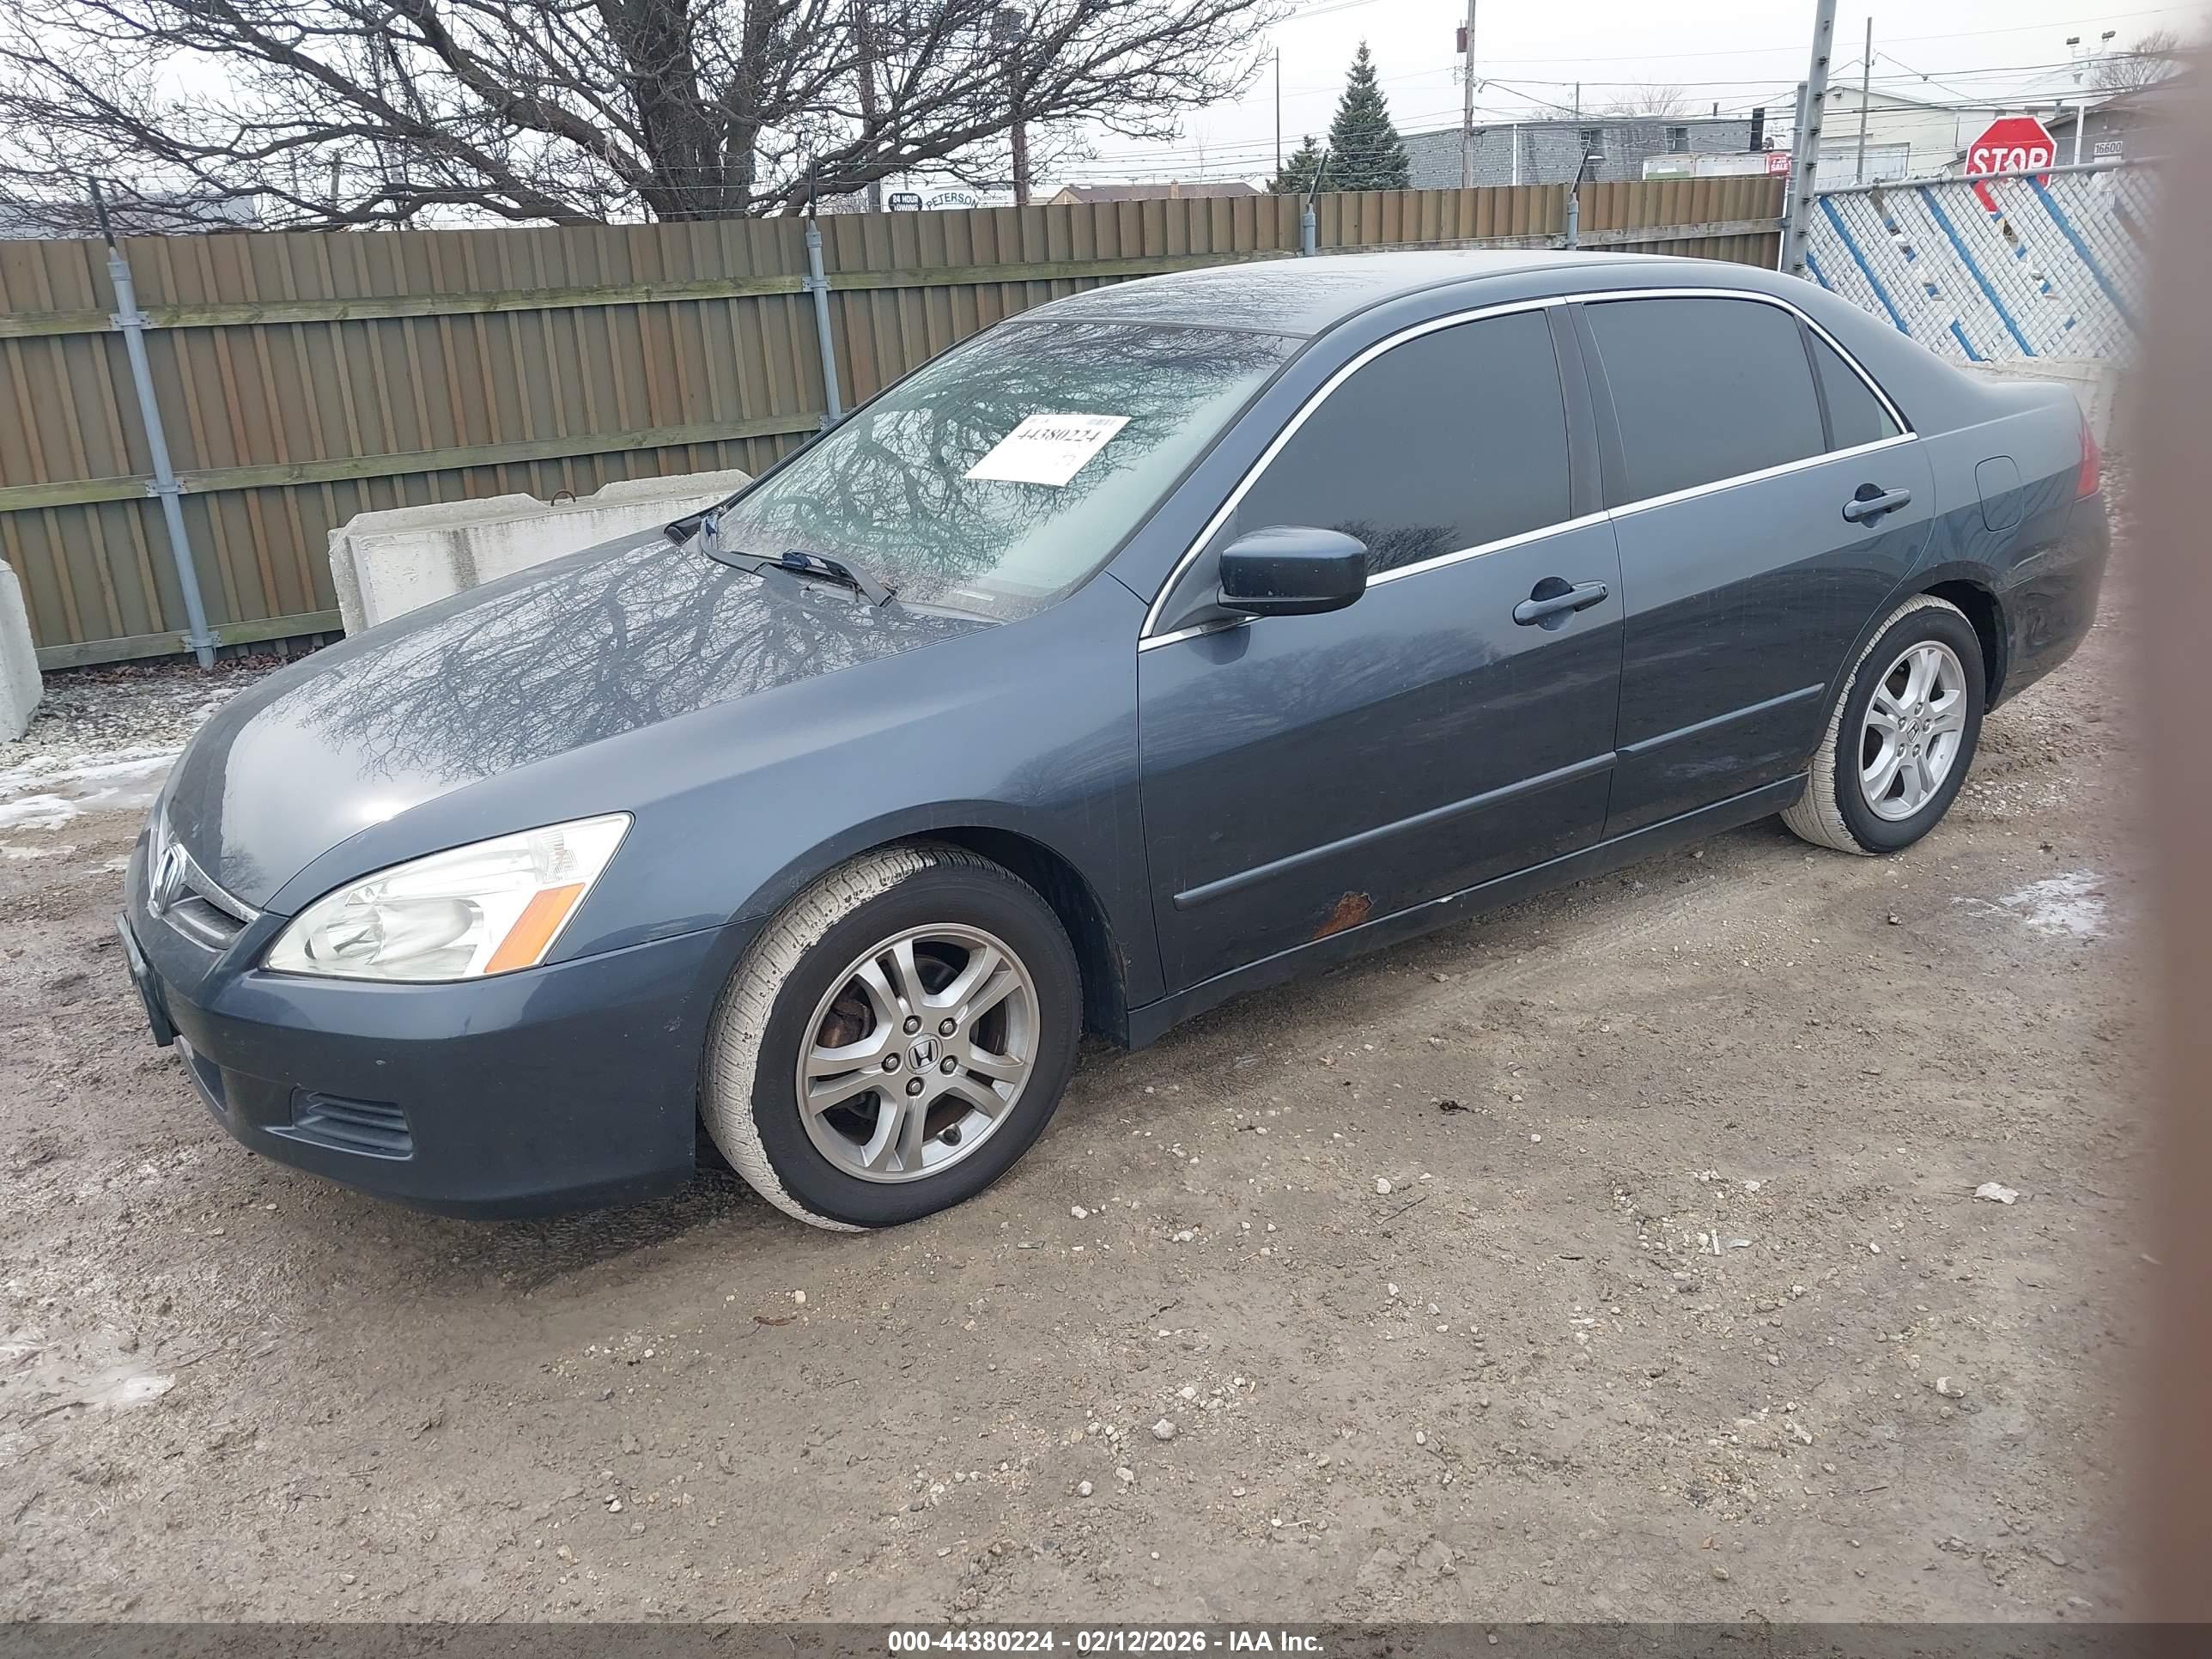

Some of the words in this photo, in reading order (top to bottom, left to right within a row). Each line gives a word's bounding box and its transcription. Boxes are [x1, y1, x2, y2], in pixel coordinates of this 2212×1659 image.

[2095, 142, 2122, 154] 16600
[1972, 147, 2048, 175] STOP
[892, 194, 901, 204] 24
[902, 194, 919, 204] HOUR
[926, 192, 979, 210] PETERSON
[1018, 428, 1102, 442] 44380224
